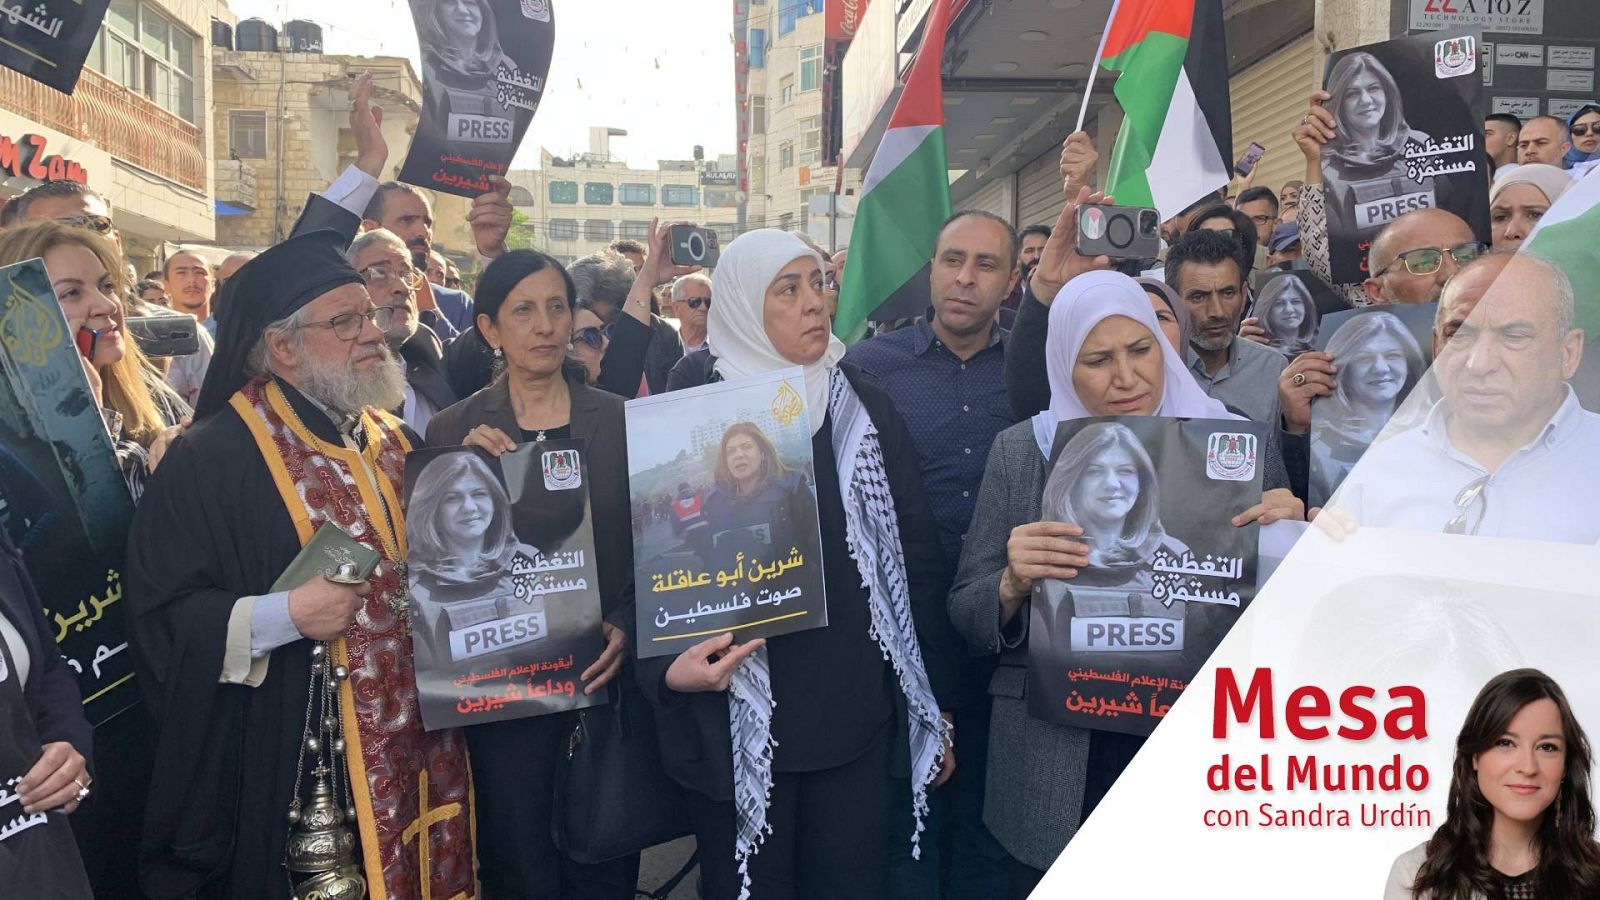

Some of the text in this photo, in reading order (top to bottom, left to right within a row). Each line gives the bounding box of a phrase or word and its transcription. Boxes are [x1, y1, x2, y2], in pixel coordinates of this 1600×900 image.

[1424, 13, 1493, 22] TECHNOLOGY
[1462, 0, 1476, 13] A
[1518, 0, 1531, 15] Z
[1514, 51, 1529, 59] CNN
[458, 118, 510, 139] PRESS
[29, 133, 88, 184] Zam
[1405, 133, 1474, 160] التغطية
[1406, 158, 1476, 184] مستمرة
[1366, 194, 1430, 224] PRESS
[512, 549, 585, 576] التغطية
[651, 547, 803, 593] شرين أبو عاقلة
[1152, 550, 1243, 579] التغطية
[513, 575, 587, 604] مستمرة
[1151, 574, 1241, 609] مستمرة
[654, 585, 802, 628] صوت فلسطين
[464, 615, 540, 654] PRESS
[1086, 622, 1176, 647] PRESS
[541, 654, 574, 672] أيقونة
[1067, 667, 1130, 683] الفلسطيني
[1130, 675, 1168, 692] الإعلام
[456, 682, 523, 714] شيرين
[1065, 690, 1143, 717] شيرين
